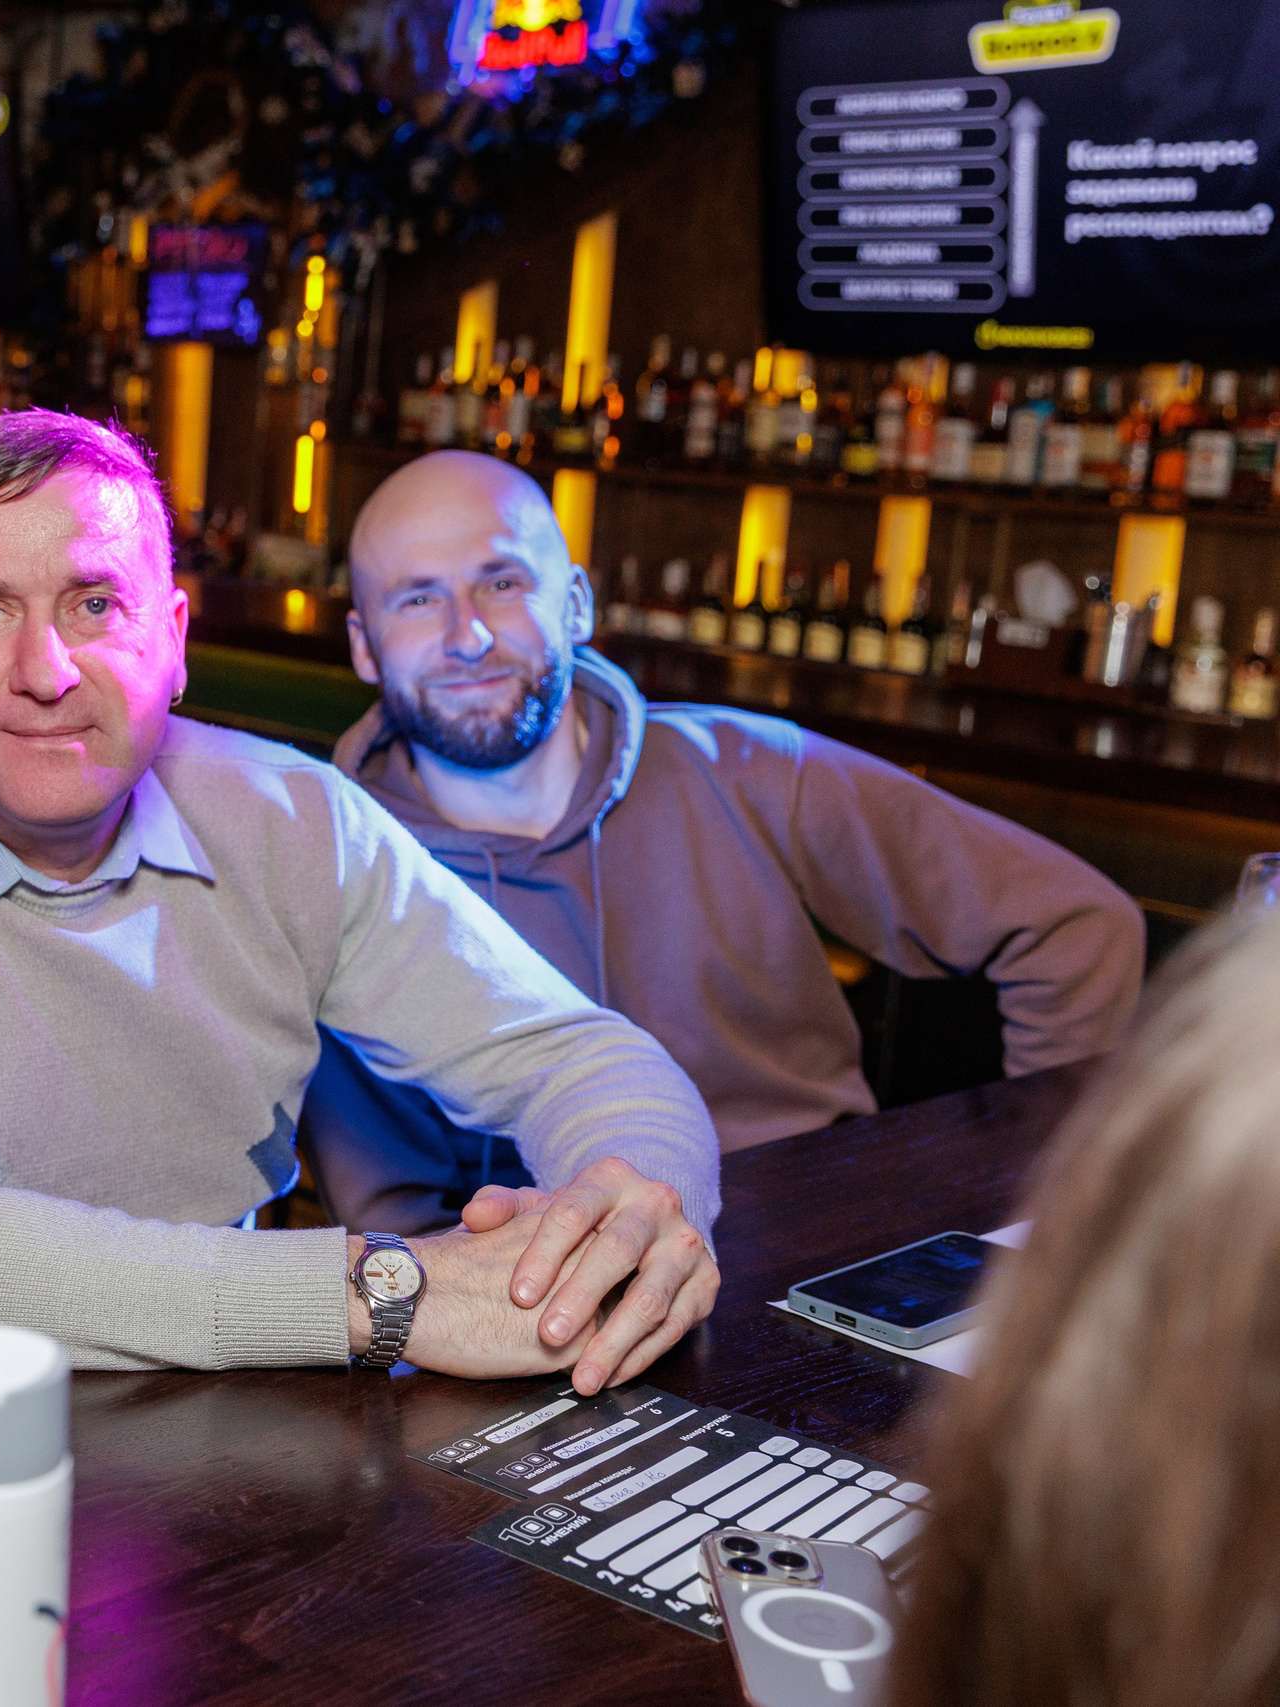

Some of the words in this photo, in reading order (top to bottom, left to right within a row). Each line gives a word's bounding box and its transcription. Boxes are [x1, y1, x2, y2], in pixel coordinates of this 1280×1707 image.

[715, 1428, 735, 1437] 5
[428, 1438, 482, 1463] 100
[456, 1446, 491, 1464] МНЕНИЙ
[496, 1452, 551, 1479] 100
[524, 1461, 560, 1480] МНЕНИЙ
[563, 1481, 602, 1501] Название
[498, 1503, 577, 1546] 100
[540, 1515, 591, 1546] МНЕНИЙ
[562, 1555, 588, 1568] 1
[596, 1570, 624, 1585] 2
[628, 1583, 656, 1599] 3
[664, 1598, 692, 1612] 4
[699, 1613, 723, 1627] 5
